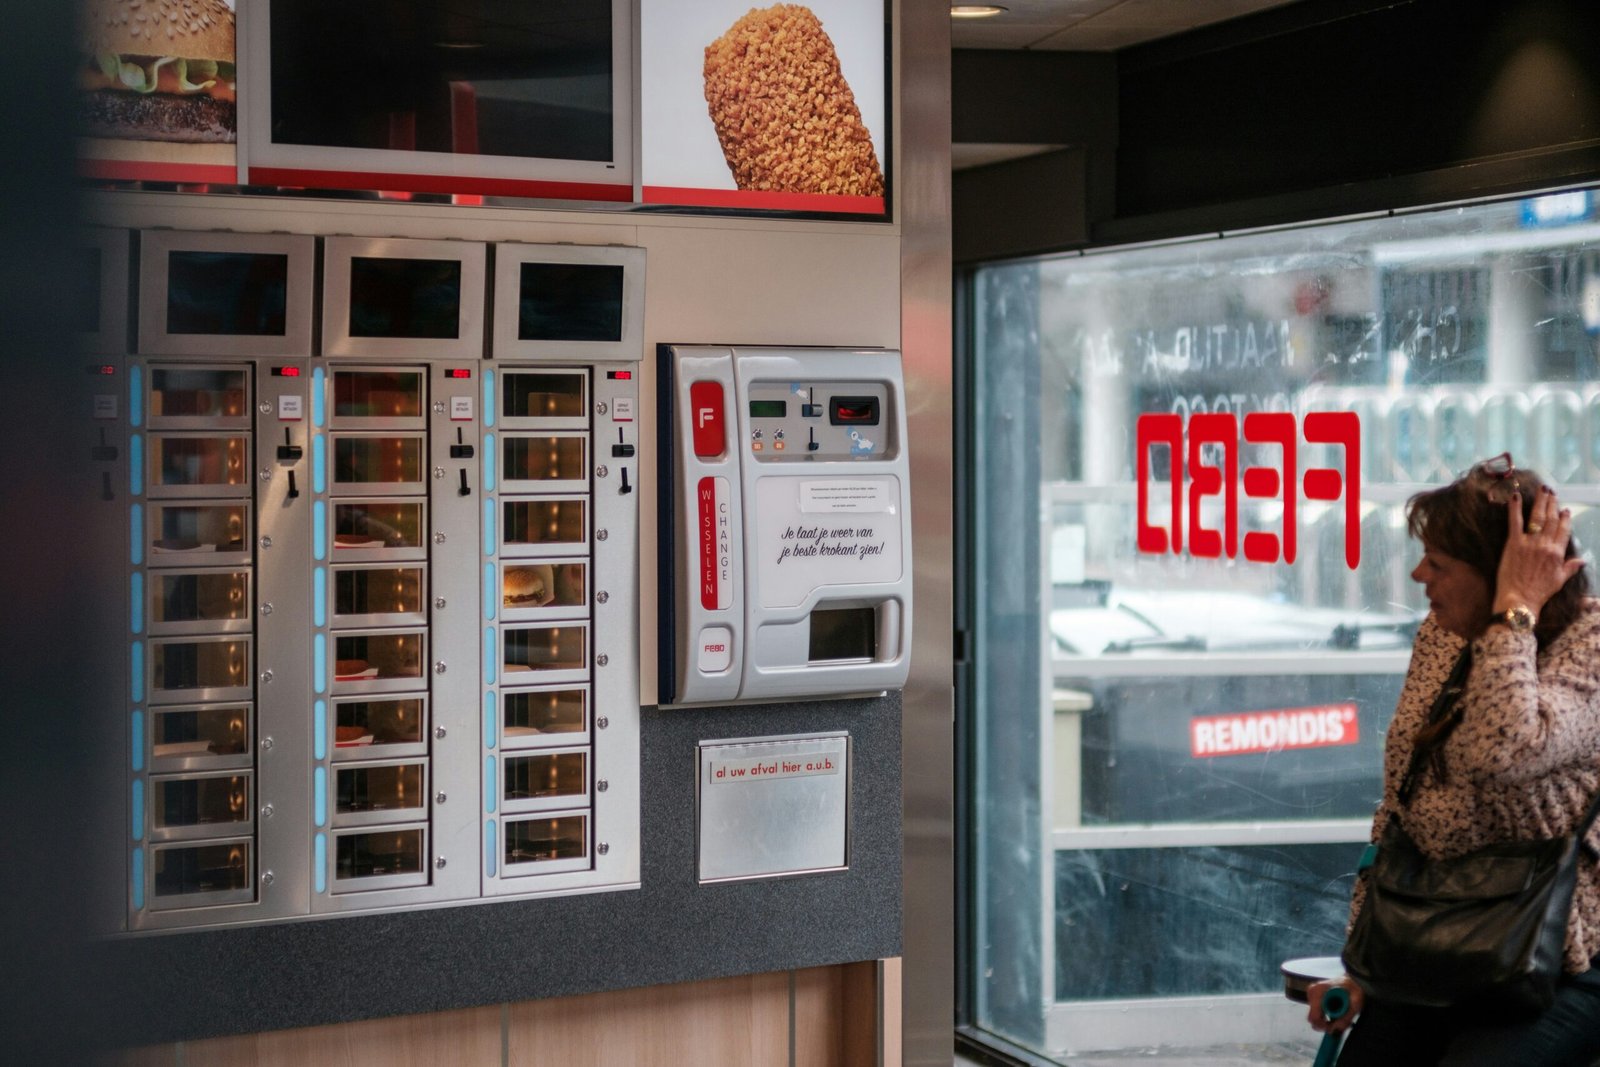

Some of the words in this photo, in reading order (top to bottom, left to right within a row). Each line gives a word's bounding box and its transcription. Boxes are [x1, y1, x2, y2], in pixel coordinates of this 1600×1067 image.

[699, 408, 714, 428] F
[701, 490, 713, 594] WISSELEN
[719, 503, 729, 581] CHANGE
[781, 526, 795, 540] Je
[796, 526, 818, 539] laat
[815, 528, 829, 545] je
[830, 528, 855, 539] weer
[856, 528, 874, 538] van
[777, 546, 791, 565] je
[792, 543, 818, 557] beste
[819, 542, 858, 556] krokant
[859, 541, 885, 560] zien!
[704, 644, 725, 653] FEBO
[1193, 708, 1345, 754] REMONDIS
[716, 766, 726, 778] al
[730, 768, 746, 777] uw
[750, 762, 778, 776] afval
[782, 761, 801, 772] hier
[806, 758, 835, 771] a.u.b.
